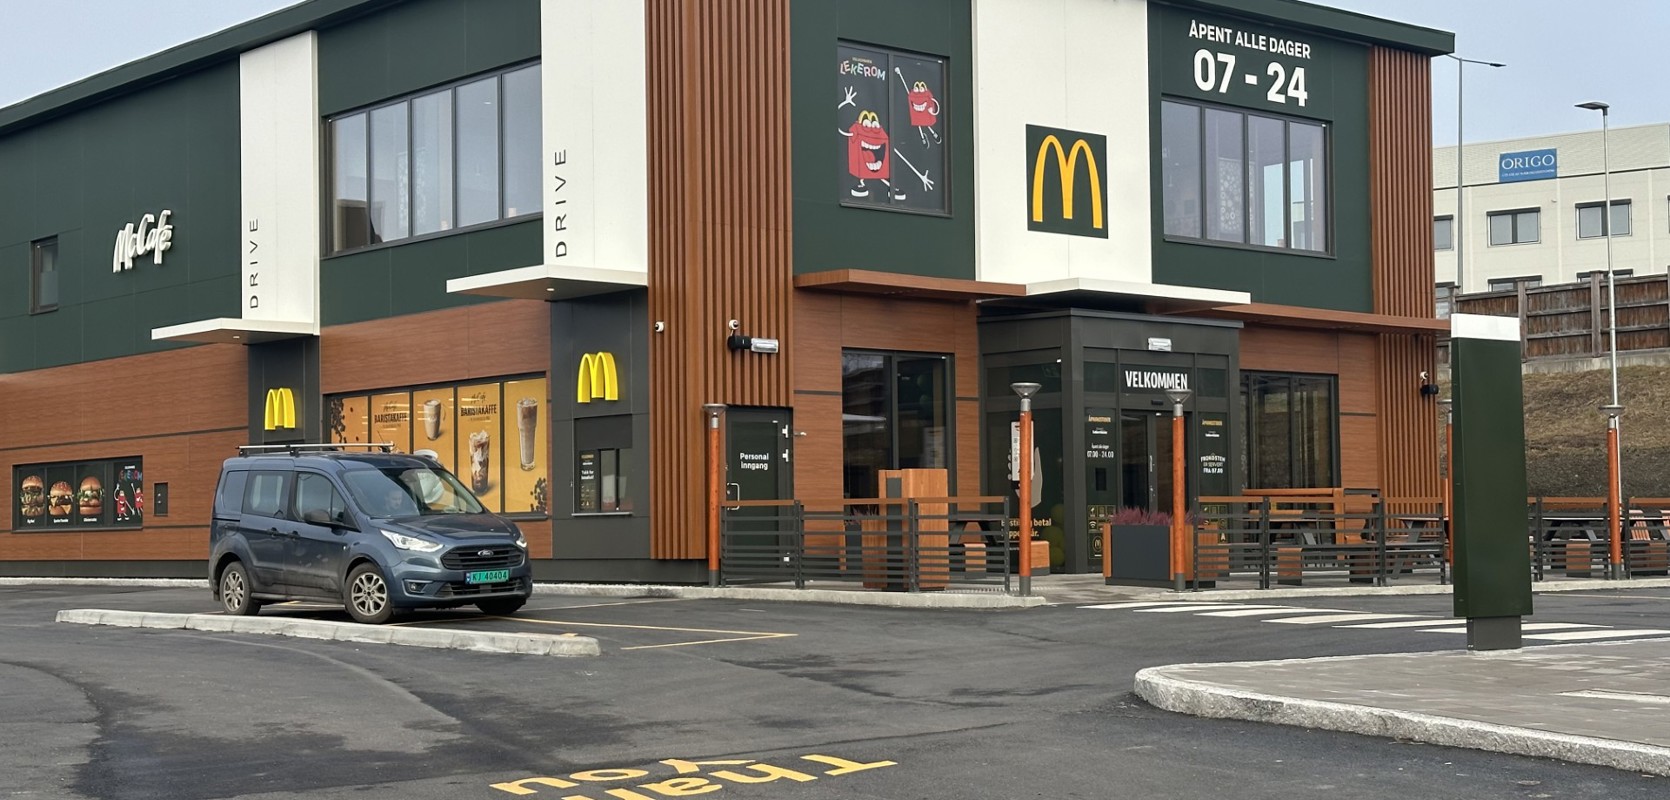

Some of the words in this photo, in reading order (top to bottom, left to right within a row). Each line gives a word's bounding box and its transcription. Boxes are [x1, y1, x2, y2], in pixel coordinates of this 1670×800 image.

[1188, 19, 1233, 44] ÅPENT
[1235, 30, 1267, 52] ALLE
[1269, 37, 1311, 60] DAGER
[840, 60, 886, 81] LEKEROM
[1193, 48, 1236, 94] 07
[1266, 61, 1308, 107] 24
[1501, 154, 1555, 170] ORIGO
[554, 149, 567, 258] DRIVE
[249, 217, 259, 309] DRIVE
[1125, 370, 1188, 390] VELKOMMEN
[740, 452, 769, 460] Personal
[1033, 518, 1052, 527] betal
[485, 570, 508, 581] 40404
[488, 758, 757, 796] You
